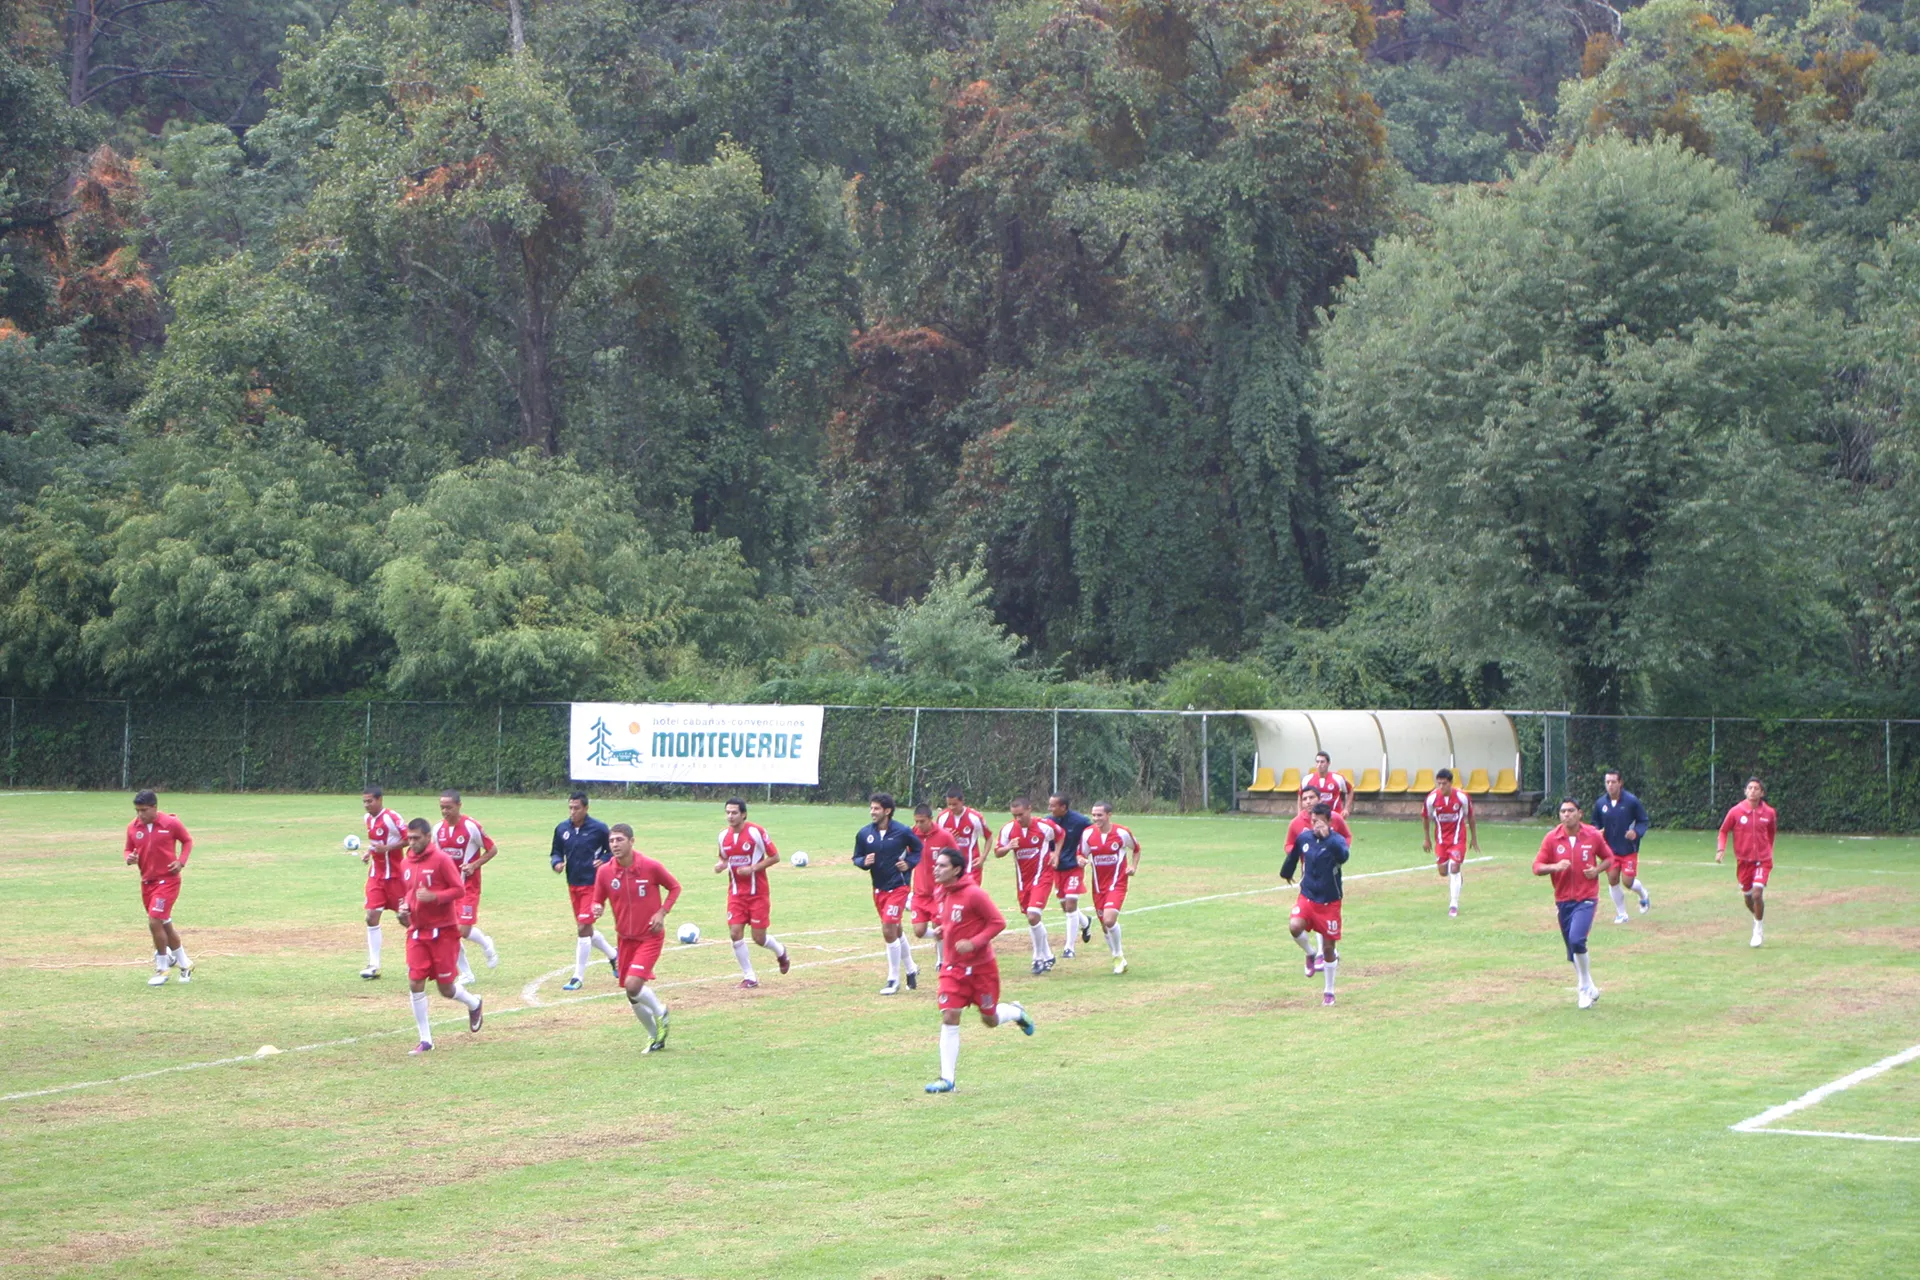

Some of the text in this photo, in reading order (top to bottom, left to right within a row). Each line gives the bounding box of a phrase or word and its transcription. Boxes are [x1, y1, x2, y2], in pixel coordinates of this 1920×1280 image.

[651, 732, 803, 759] MONTEVERDE
[1582, 850, 1589, 861] 5
[638, 885, 646, 897] 6
[886, 904, 900, 917] 20
